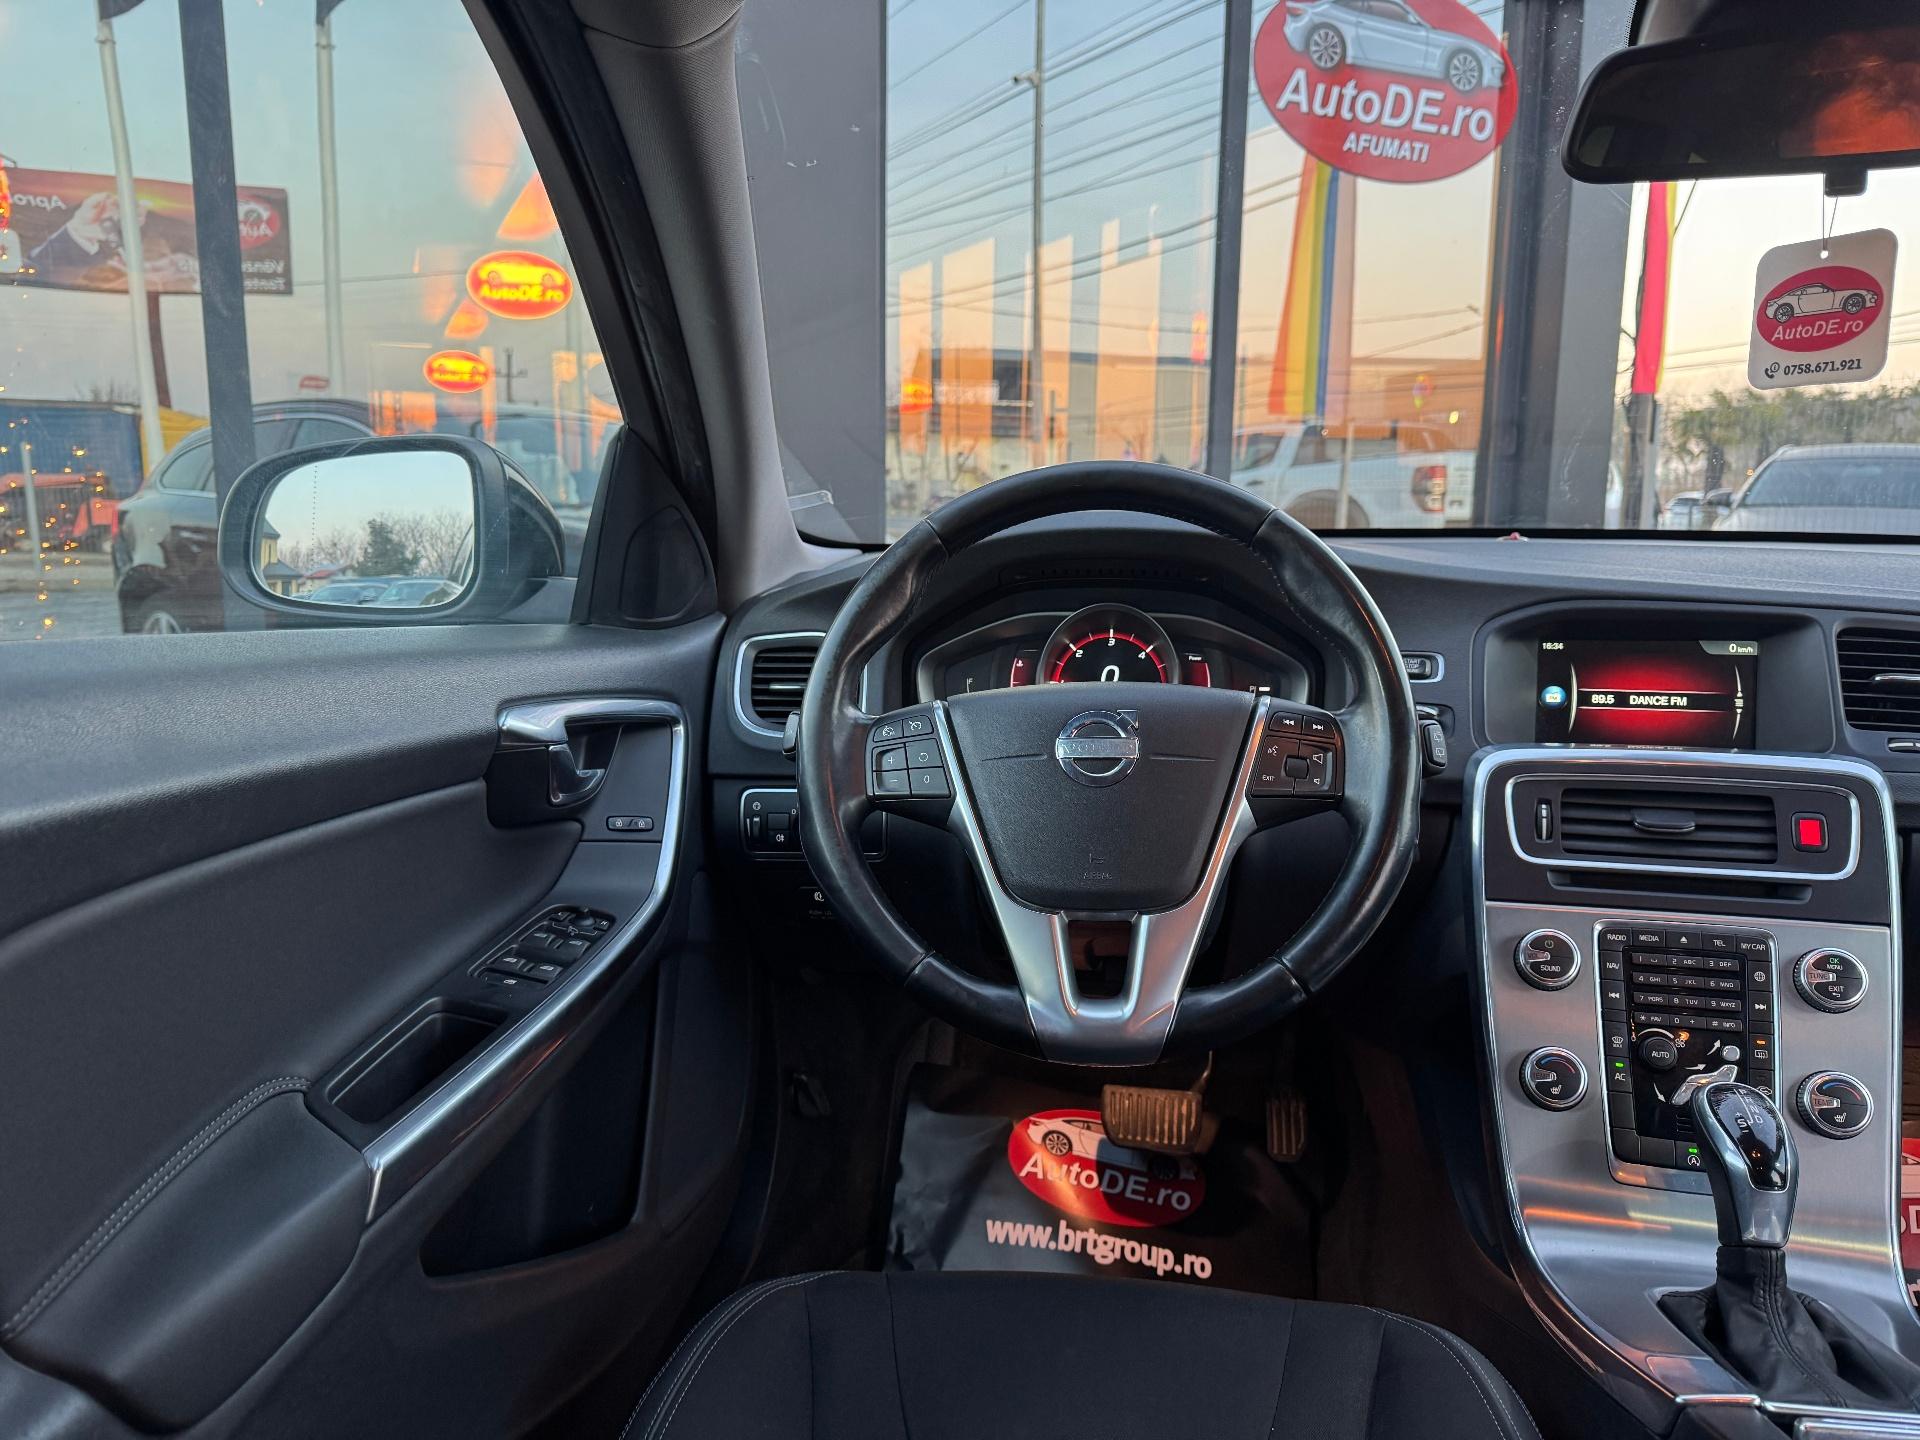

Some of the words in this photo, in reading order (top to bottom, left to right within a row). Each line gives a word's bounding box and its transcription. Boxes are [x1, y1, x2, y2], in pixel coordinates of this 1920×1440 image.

[1276, 68, 1494, 141] AutoDE.ro
[1343, 132, 1430, 162] AFUMATI
[1771, 319, 1864, 342] AutoDE.ro
[1783, 358, 1862, 376] 0758.671.921
[1108, 638, 1116, 647] 3
[1729, 643, 1737, 653] 0
[1075, 650, 1084, 658] 2
[1138, 651, 1146, 660] 4
[1591, 694, 1616, 705] 89.5
[1629, 695, 1669, 706] DANCE
[1670, 696, 1688, 707] FM
[1607, 933, 1626, 941] RADIO
[1639, 934, 1659, 942] MEDIA
[1713, 939, 1726, 947] TEL
[1751, 943, 1766, 951] CAR
[1540, 964, 1561, 972] SOUND
[1606, 962, 1620, 970] NAV
[1651, 1050, 1670, 1059] AUTO
[1614, 1072, 1626, 1081] AC
[1019, 1152, 1192, 1211] AutoDE.ro
[986, 1219, 1213, 1279] www.brtgroup.ro
